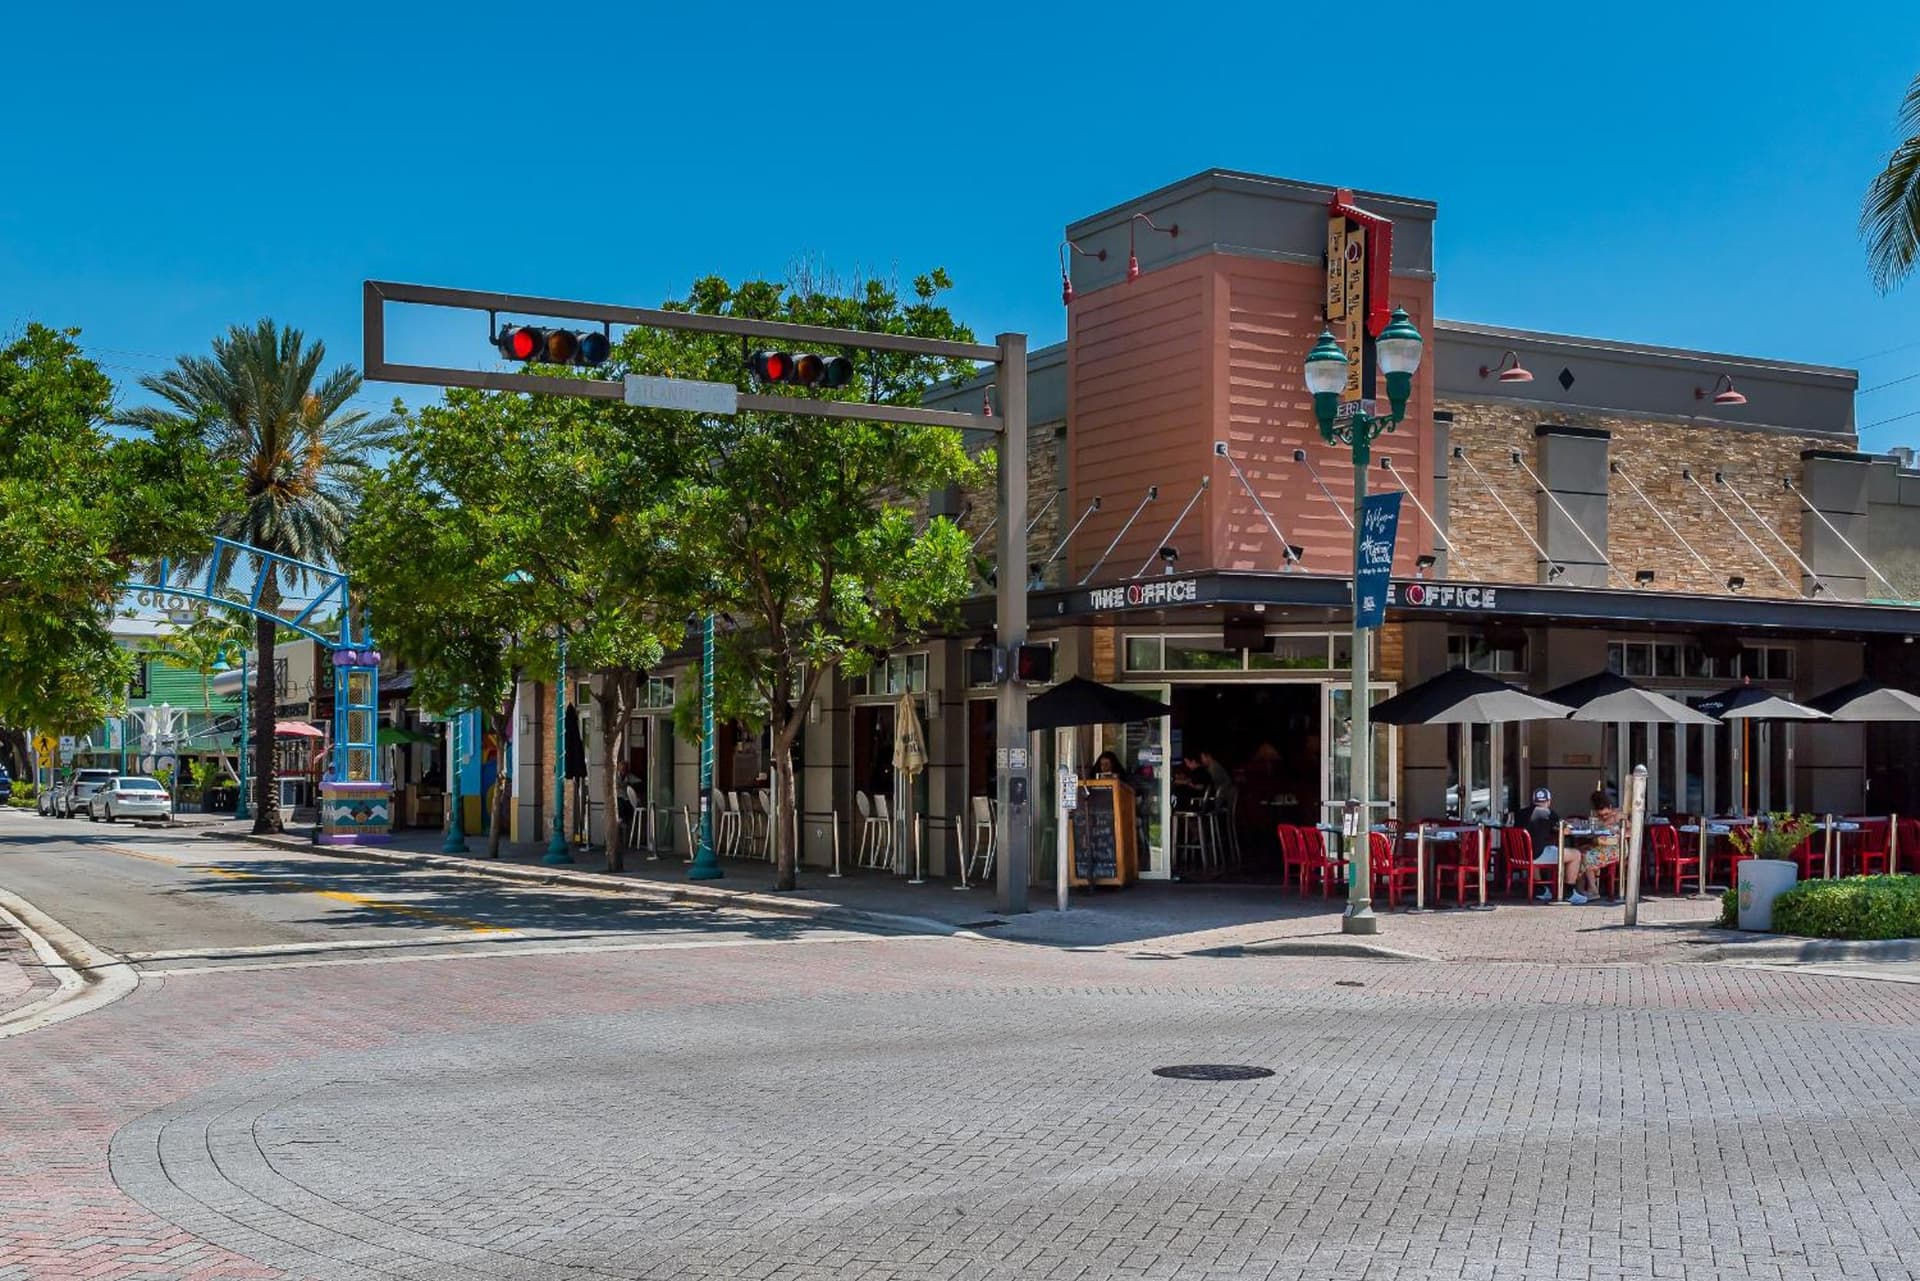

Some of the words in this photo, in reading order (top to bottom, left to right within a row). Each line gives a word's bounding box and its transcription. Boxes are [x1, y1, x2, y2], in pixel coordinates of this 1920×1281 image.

[1089, 586, 1124, 610] THE
[1127, 580, 1196, 604] OFFICE
[1405, 584, 1496, 608] OFFICE
